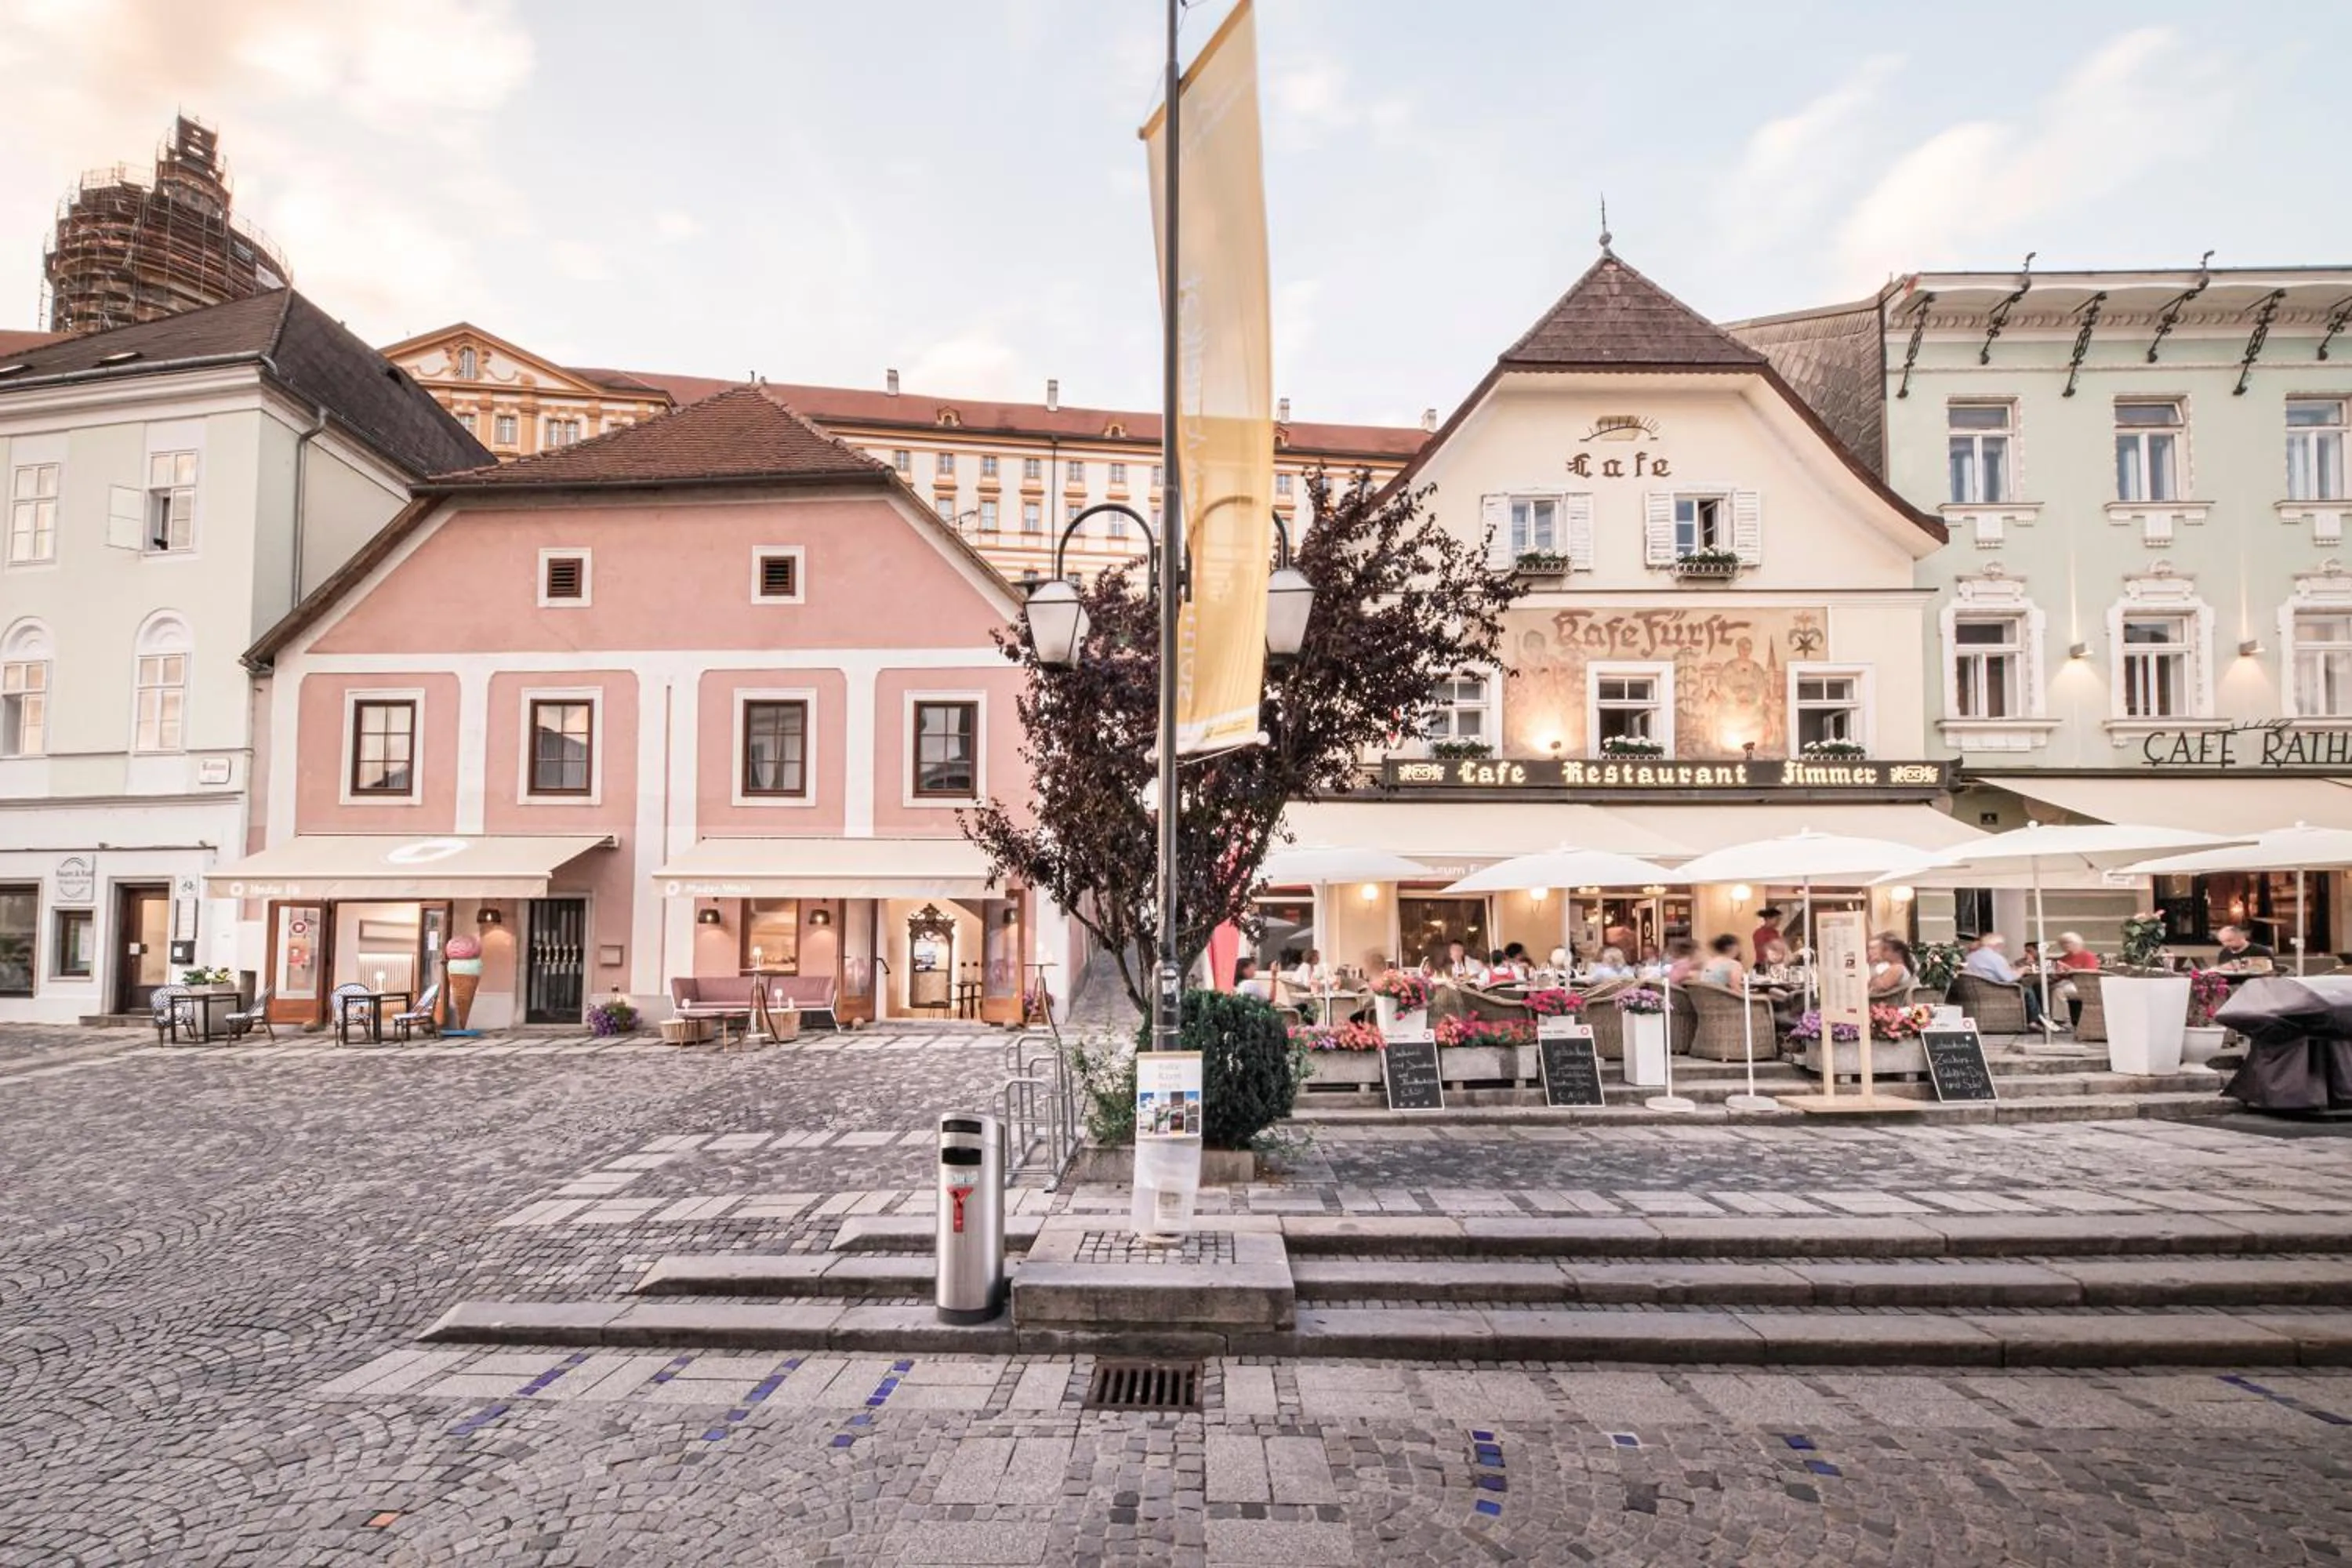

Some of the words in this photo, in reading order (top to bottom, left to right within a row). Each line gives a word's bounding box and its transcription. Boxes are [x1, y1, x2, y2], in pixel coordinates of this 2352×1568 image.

[1566, 451, 1671, 478] Cafe
[1632, 609, 1752, 659] Fürst
[2261, 731, 2352, 767] RATH
[1457, 760, 1526, 785] Cafe
[1562, 760, 1748, 785] Restaurant
